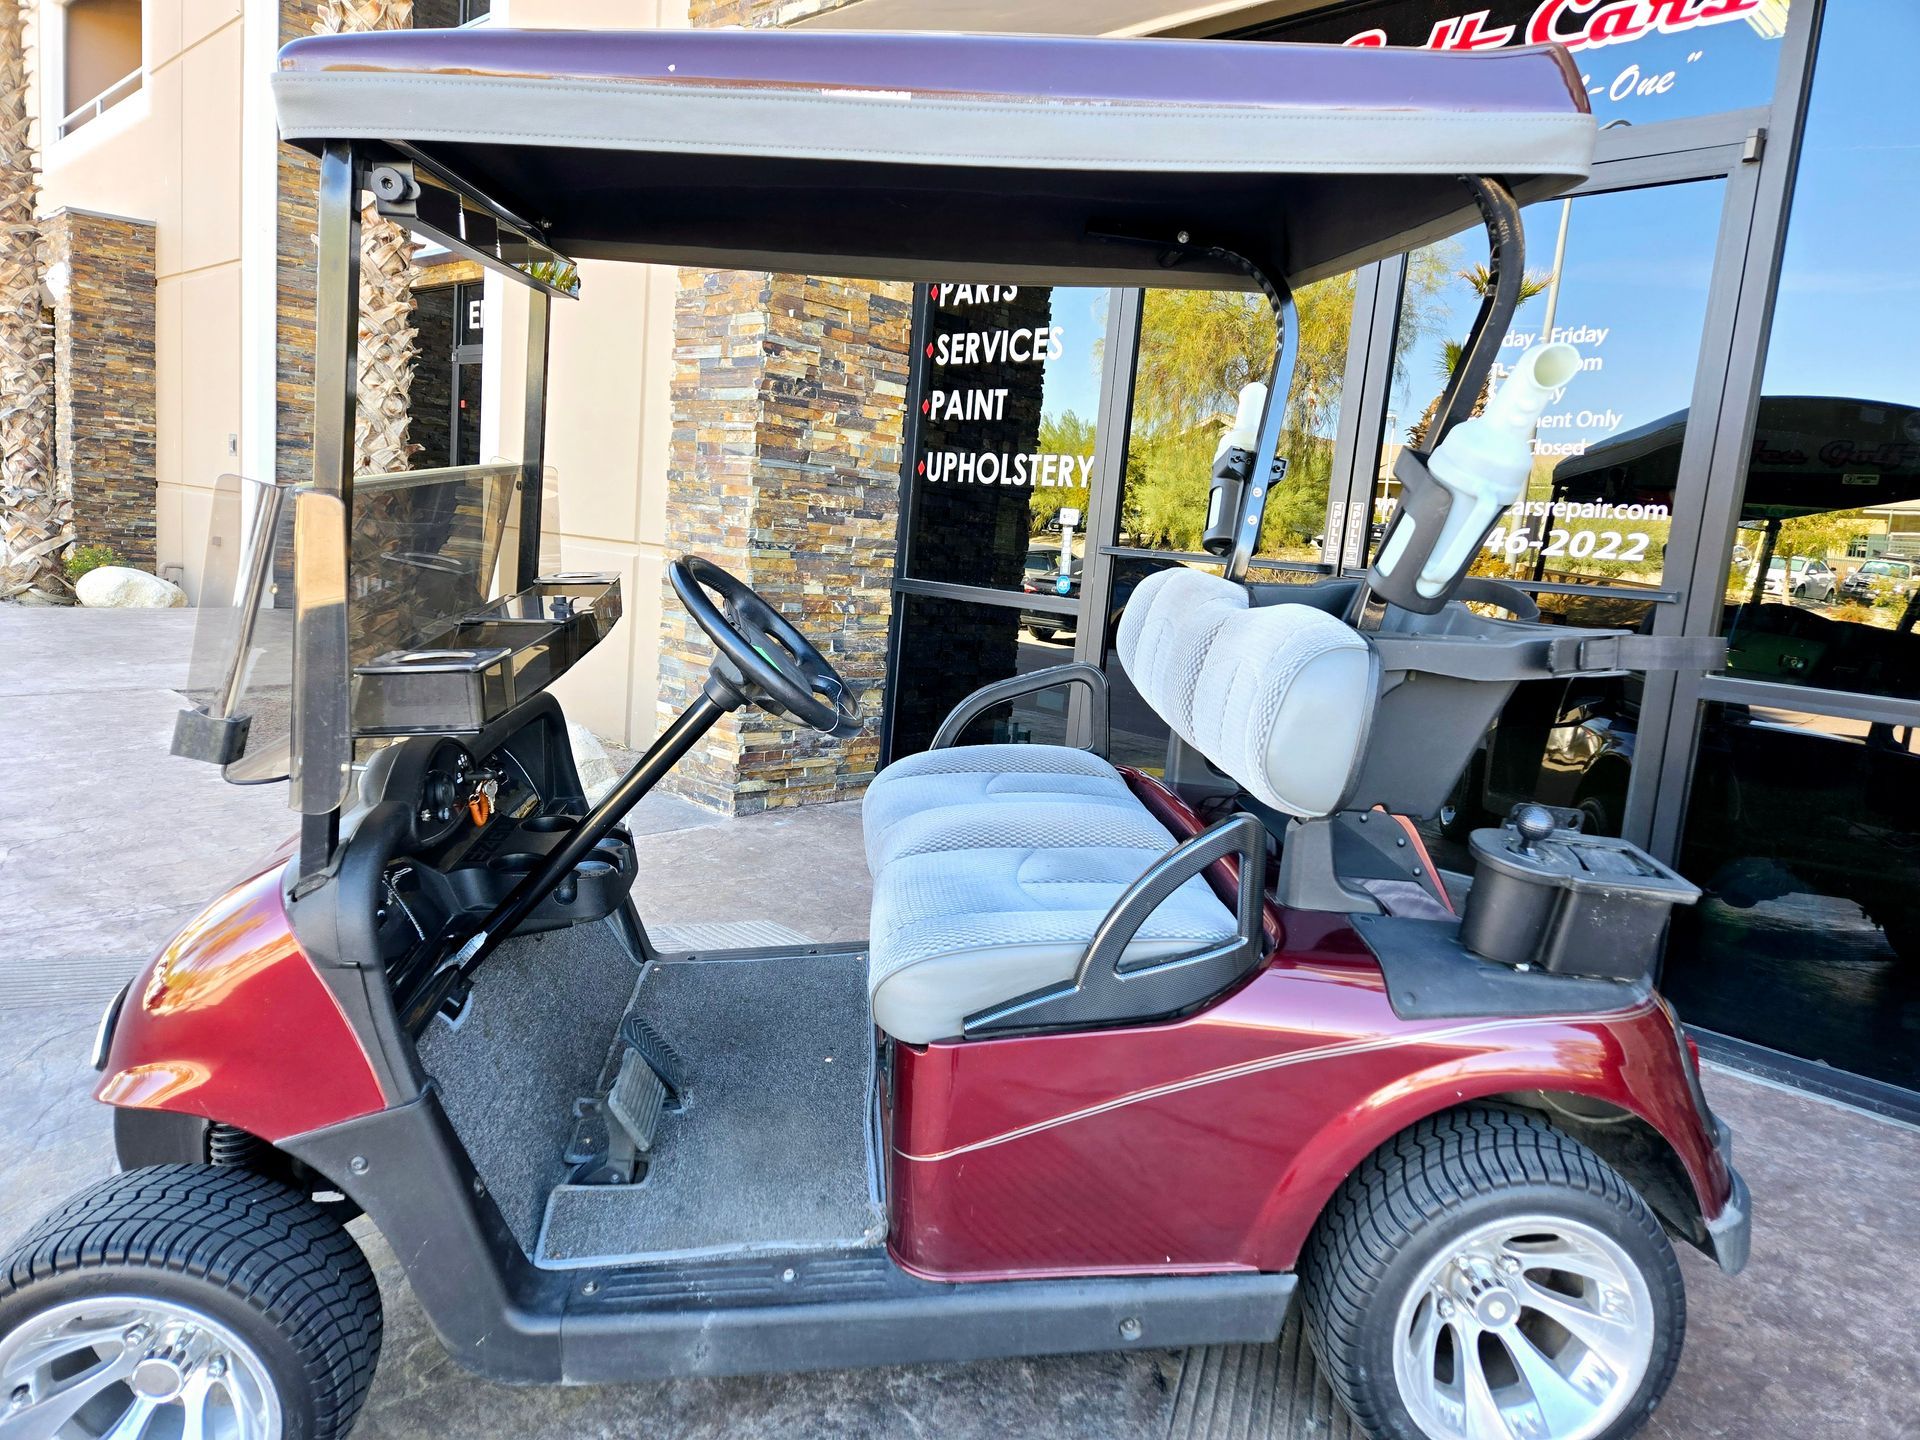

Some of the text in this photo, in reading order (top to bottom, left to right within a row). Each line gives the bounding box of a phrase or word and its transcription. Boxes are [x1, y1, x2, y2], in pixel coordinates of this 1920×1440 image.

[935, 326, 1064, 366] SERVICES
[1551, 325, 1609, 347] Friday
[930, 388, 1008, 421] PAINT
[1576, 409, 1624, 427] Only
[926, 451, 1095, 488] UPHOLSTERY
[1483, 527, 1650, 562] 46-2022
